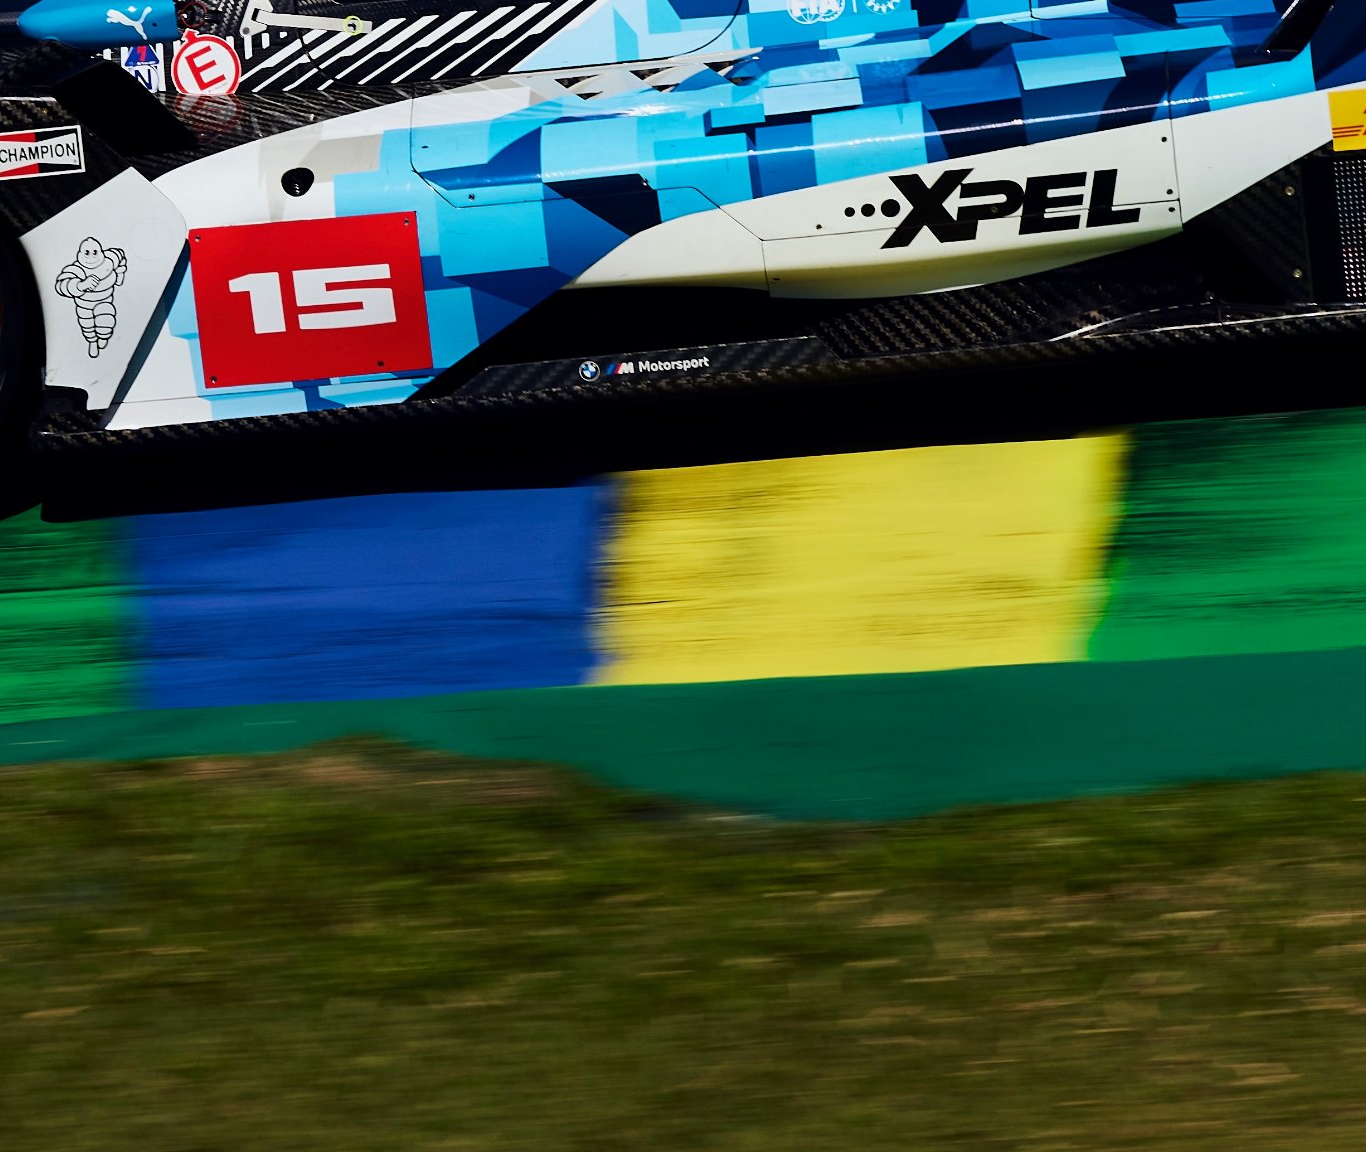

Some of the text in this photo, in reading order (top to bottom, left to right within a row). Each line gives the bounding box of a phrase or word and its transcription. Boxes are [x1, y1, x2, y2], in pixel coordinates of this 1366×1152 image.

[185, 45, 227, 91] E
[880, 167, 1141, 250] XPEL
[228, 263, 397, 335] 15
[638, 356, 710, 373] Motorsport
